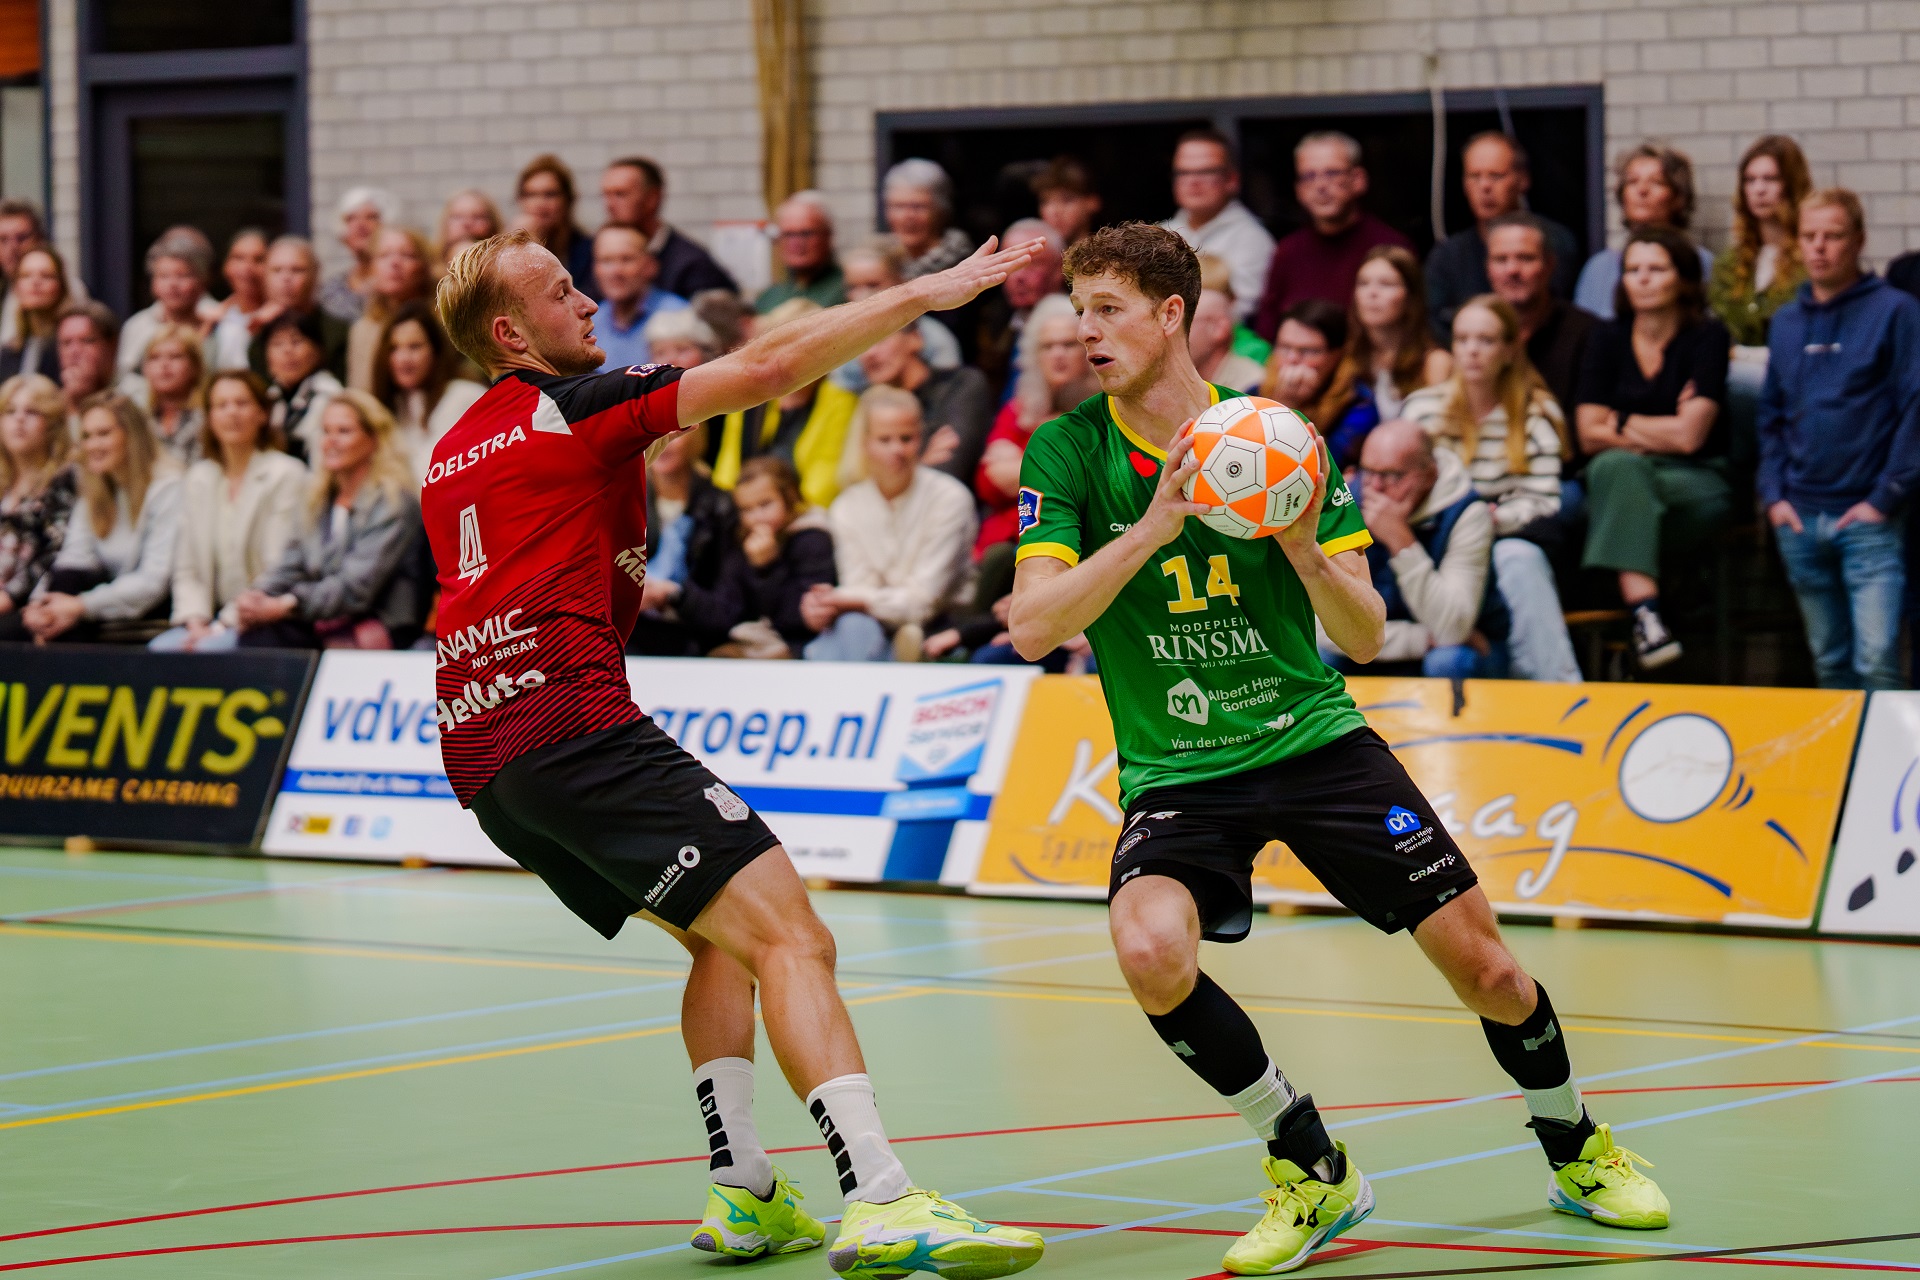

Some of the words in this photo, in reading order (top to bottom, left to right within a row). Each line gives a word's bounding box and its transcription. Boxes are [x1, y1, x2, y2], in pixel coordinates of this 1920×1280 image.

[422, 425, 527, 488] OELSTRA
[1109, 522, 1137, 533] CRA
[457, 503, 488, 587] 4
[1161, 554, 1240, 614] 14
[436, 608, 537, 670] NAMIC
[472, 638, 538, 669] NO-BREAK
[1200, 661, 1216, 669] WIJ
[1219, 659, 1236, 667] VAN
[1208, 683, 1249, 701] Albert
[1221, 688, 1280, 712] Gorredijk
[0, 682, 269, 774] VENTS
[1171, 738, 1193, 750] Van
[1197, 737, 1216, 748] der
[1219, 733, 1251, 746] Veen
[121, 778, 240, 808] CATERING
[1394, 835, 1417, 851] Albert
[1416, 826, 1434, 840] Heijn
[1404, 835, 1433, 853] Gorredijk
[1409, 857, 1446, 881] CRAFT
[644, 881, 665, 904] Prima
[661, 863, 680, 883] Life
